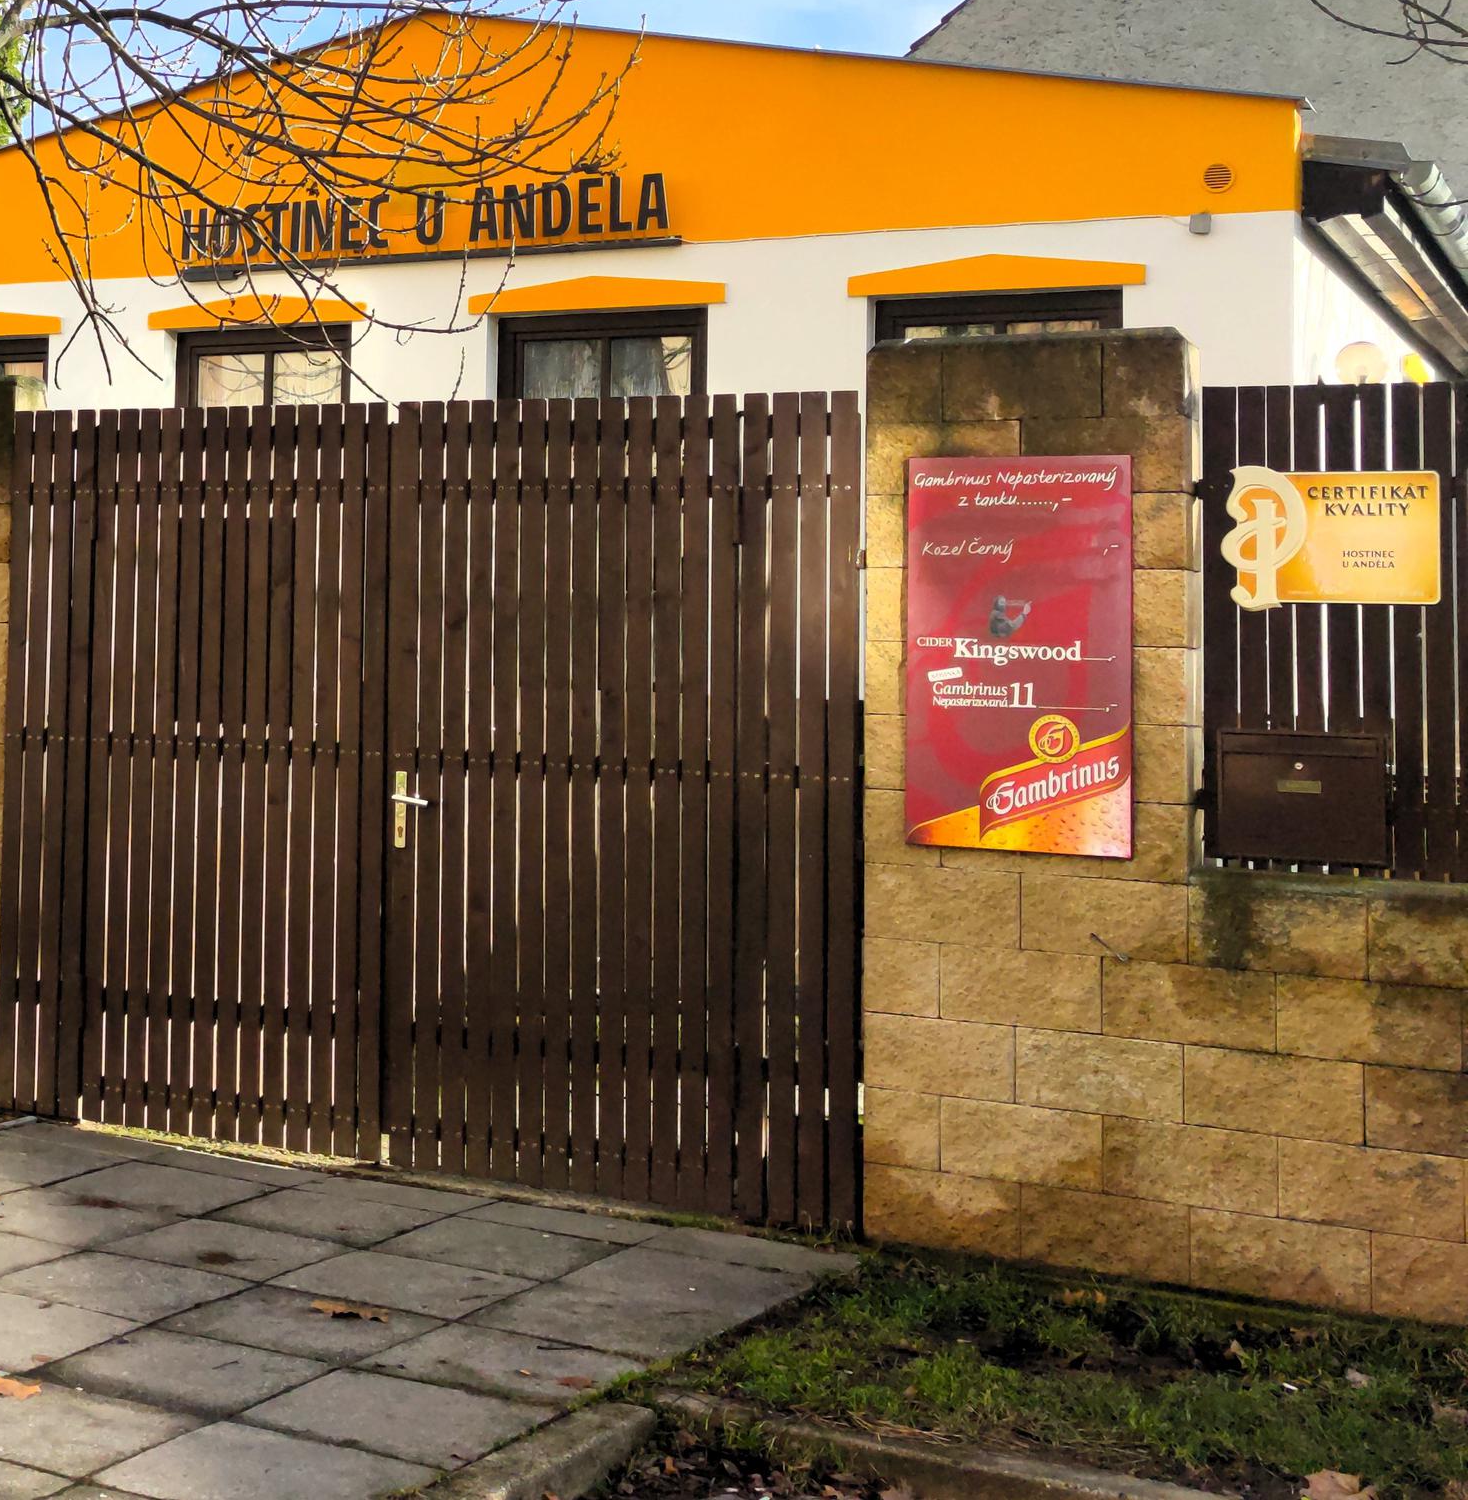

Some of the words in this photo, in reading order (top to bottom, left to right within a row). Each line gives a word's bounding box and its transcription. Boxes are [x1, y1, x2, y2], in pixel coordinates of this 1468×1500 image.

[182, 194, 390, 260] HOSTINEC
[416, 191, 445, 245] U
[914, 471, 991, 488] Gambrinus
[996, 466, 1117, 491] Nepasterizovaný
[958, 496, 969, 506] z
[1307, 483, 1429, 500] CERTIFIKÁT
[1325, 502, 1410, 517] KVALITY
[922, 540, 965, 556] Kozel
[968, 537, 1014, 563] Černý
[1342, 550, 1395, 558] HOSTINEC
[1342, 560, 1349, 568] U
[917, 637, 953, 647] CIDER
[953, 637, 1082, 666] Kingswood
[932, 681, 1008, 696] Gambrinus
[1009, 683, 1036, 708] 11
[932, 696, 1008, 708] Nepasterizovaná
[986, 756, 1120, 815] Gambrinus
